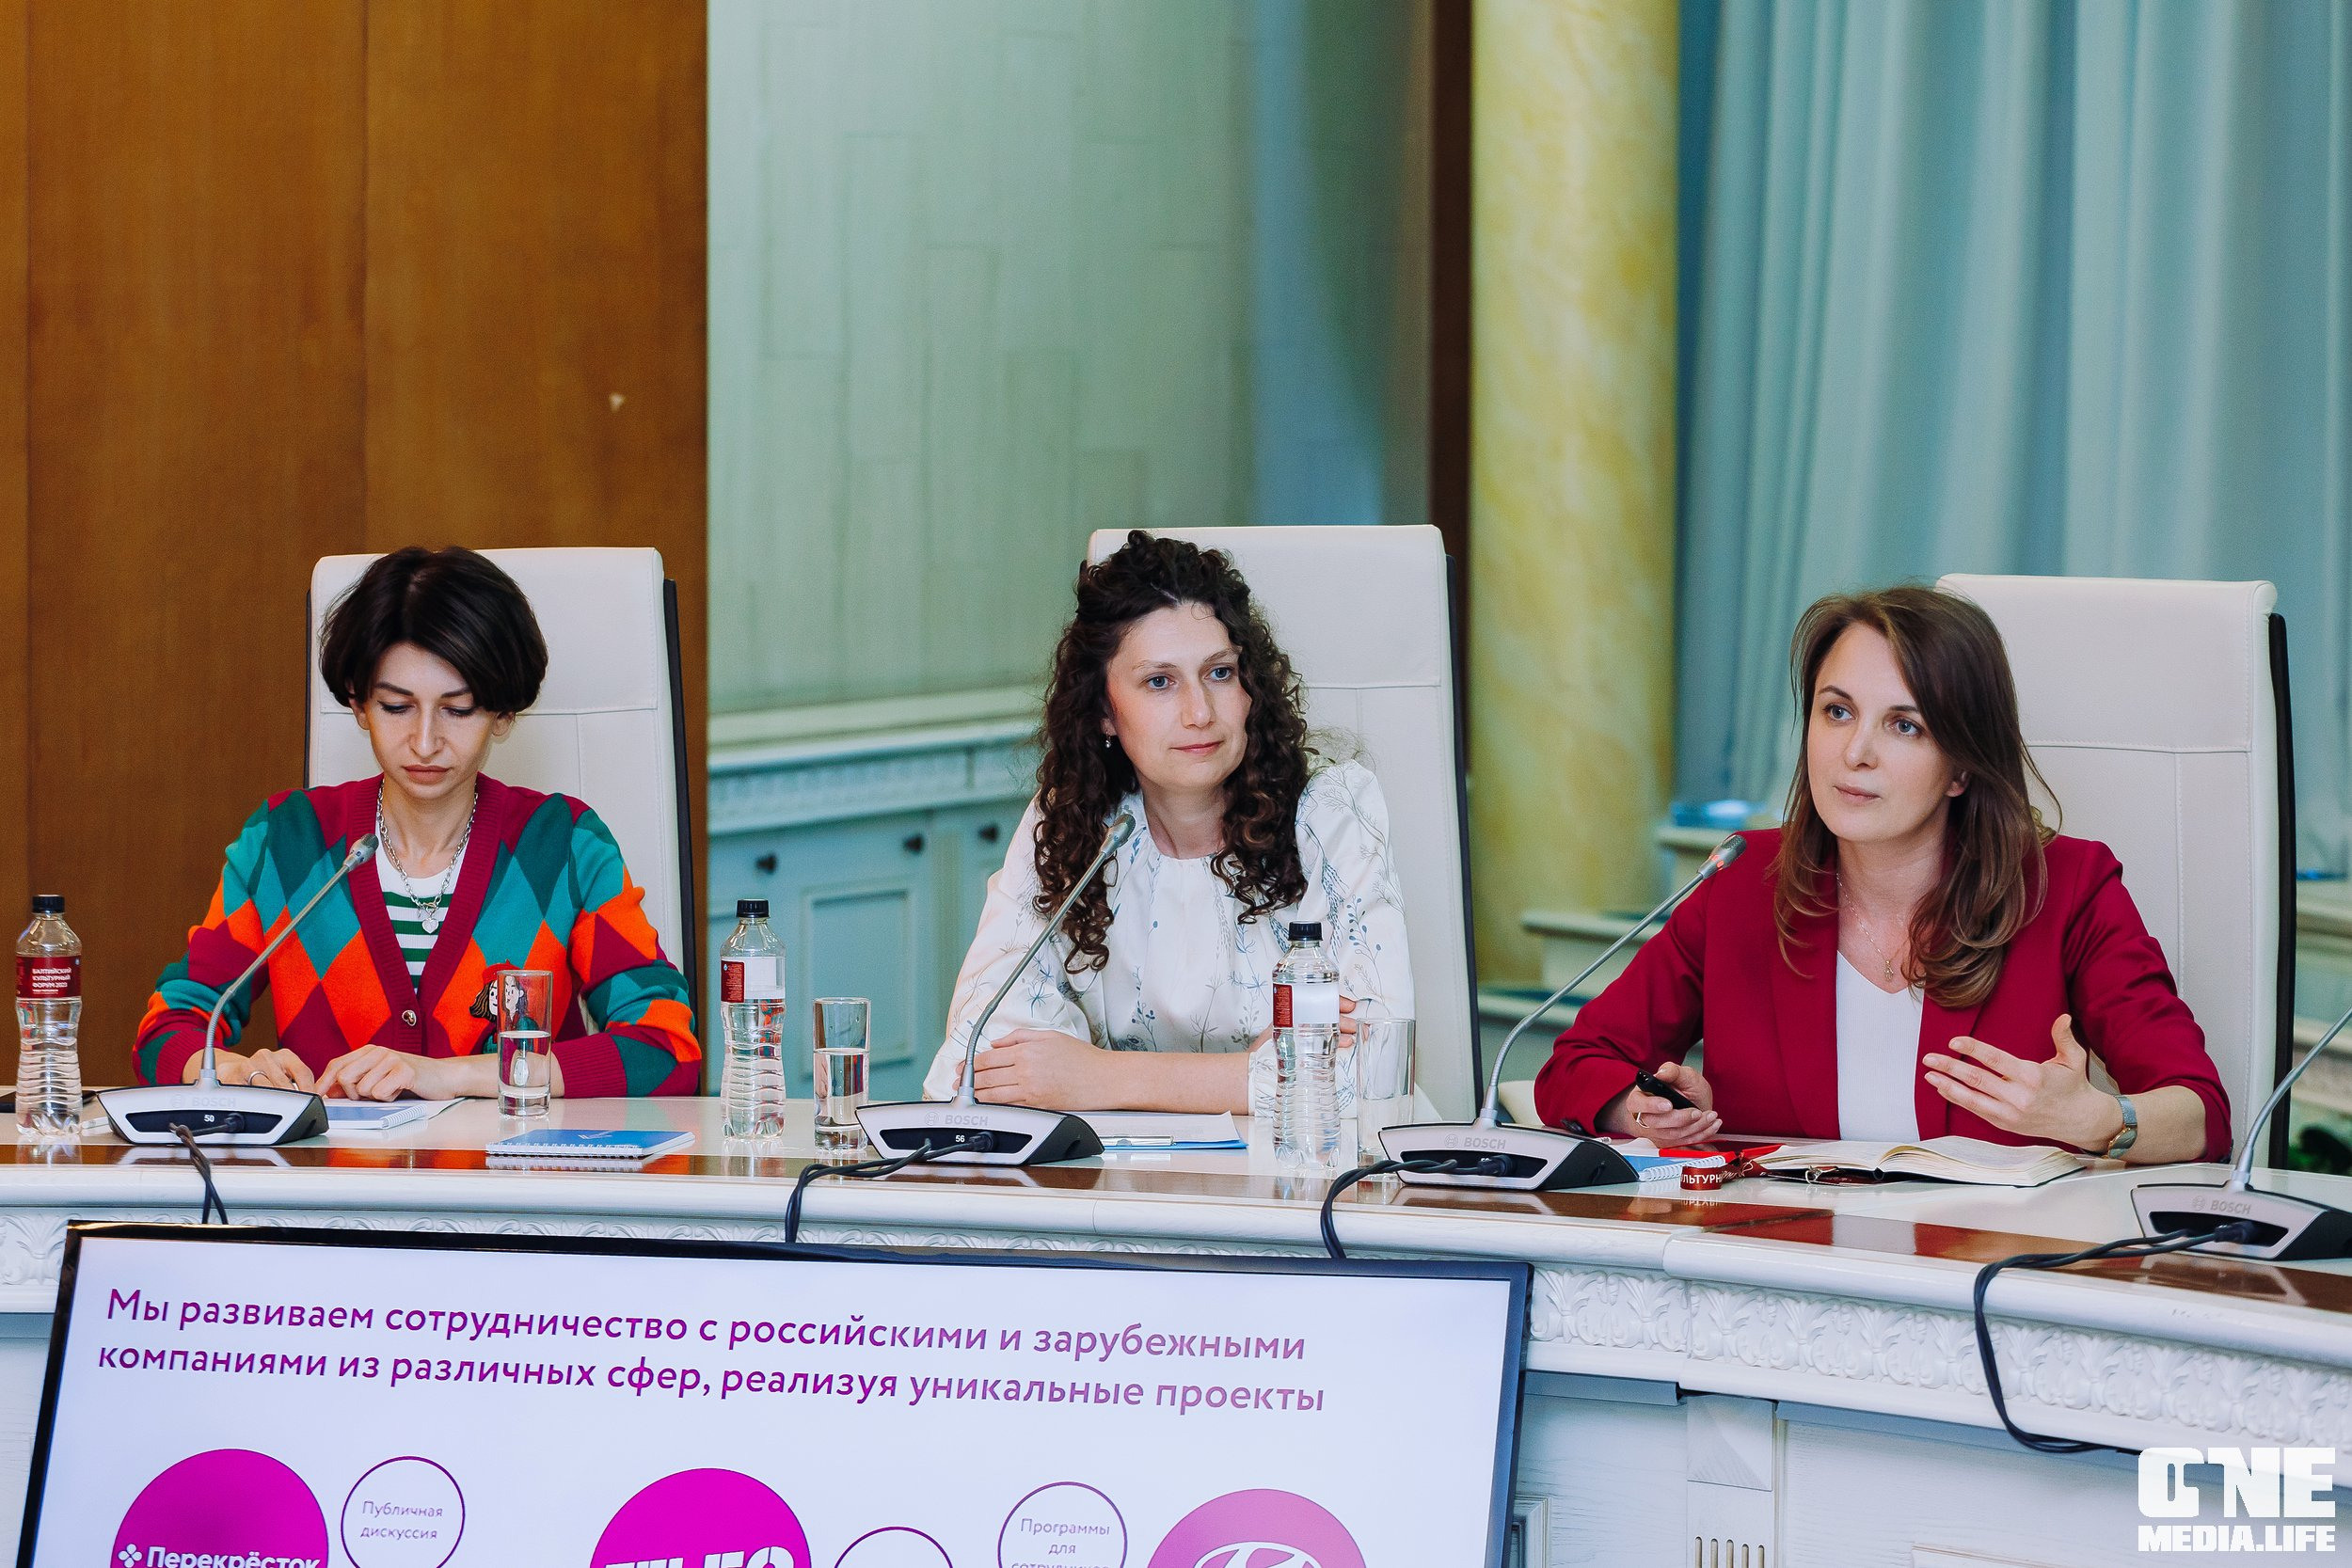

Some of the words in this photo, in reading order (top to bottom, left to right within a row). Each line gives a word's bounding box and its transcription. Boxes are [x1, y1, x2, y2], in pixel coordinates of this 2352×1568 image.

[192, 1097, 236, 1107] BOSCH
[204, 1114, 215, 1122] 50
[945, 1115, 989, 1126] BOSCH
[955, 1134, 965, 1143] 56
[1464, 1137, 1506, 1149] BOSCH
[1681, 1174, 1722, 1184] ЛЬТУРН
[2211, 1199, 2252, 1215] BOSCH
[107, 1289, 168, 1321] Мы
[179, 1302, 373, 1331] развиваем
[386, 1308, 687, 1341] сотрудничество
[699, 1320, 718, 1340] с
[729, 1315, 986, 1350] российскими
[1000, 1330, 1021, 1351] и
[1034, 1323, 1304, 1362] зарубежными
[99, 1347, 326, 1376] компаниями
[339, 1356, 379, 1378] из
[390, 1358, 596, 1387] различных
[608, 1356, 709, 1399] сфер,
[722, 1370, 897, 1404] реализуя
[909, 1377, 1143, 1407] уникальные
[1156, 1386, 1323, 1415] проекты
[362, 1500, 443, 1517] Публичная
[1021, 1518, 1110, 1536] Программы
[360, 1528, 437, 1540] дискуссия
[1048, 1544, 1076, 1555] для
[147, 1545, 321, 1568] Перекрёсток
